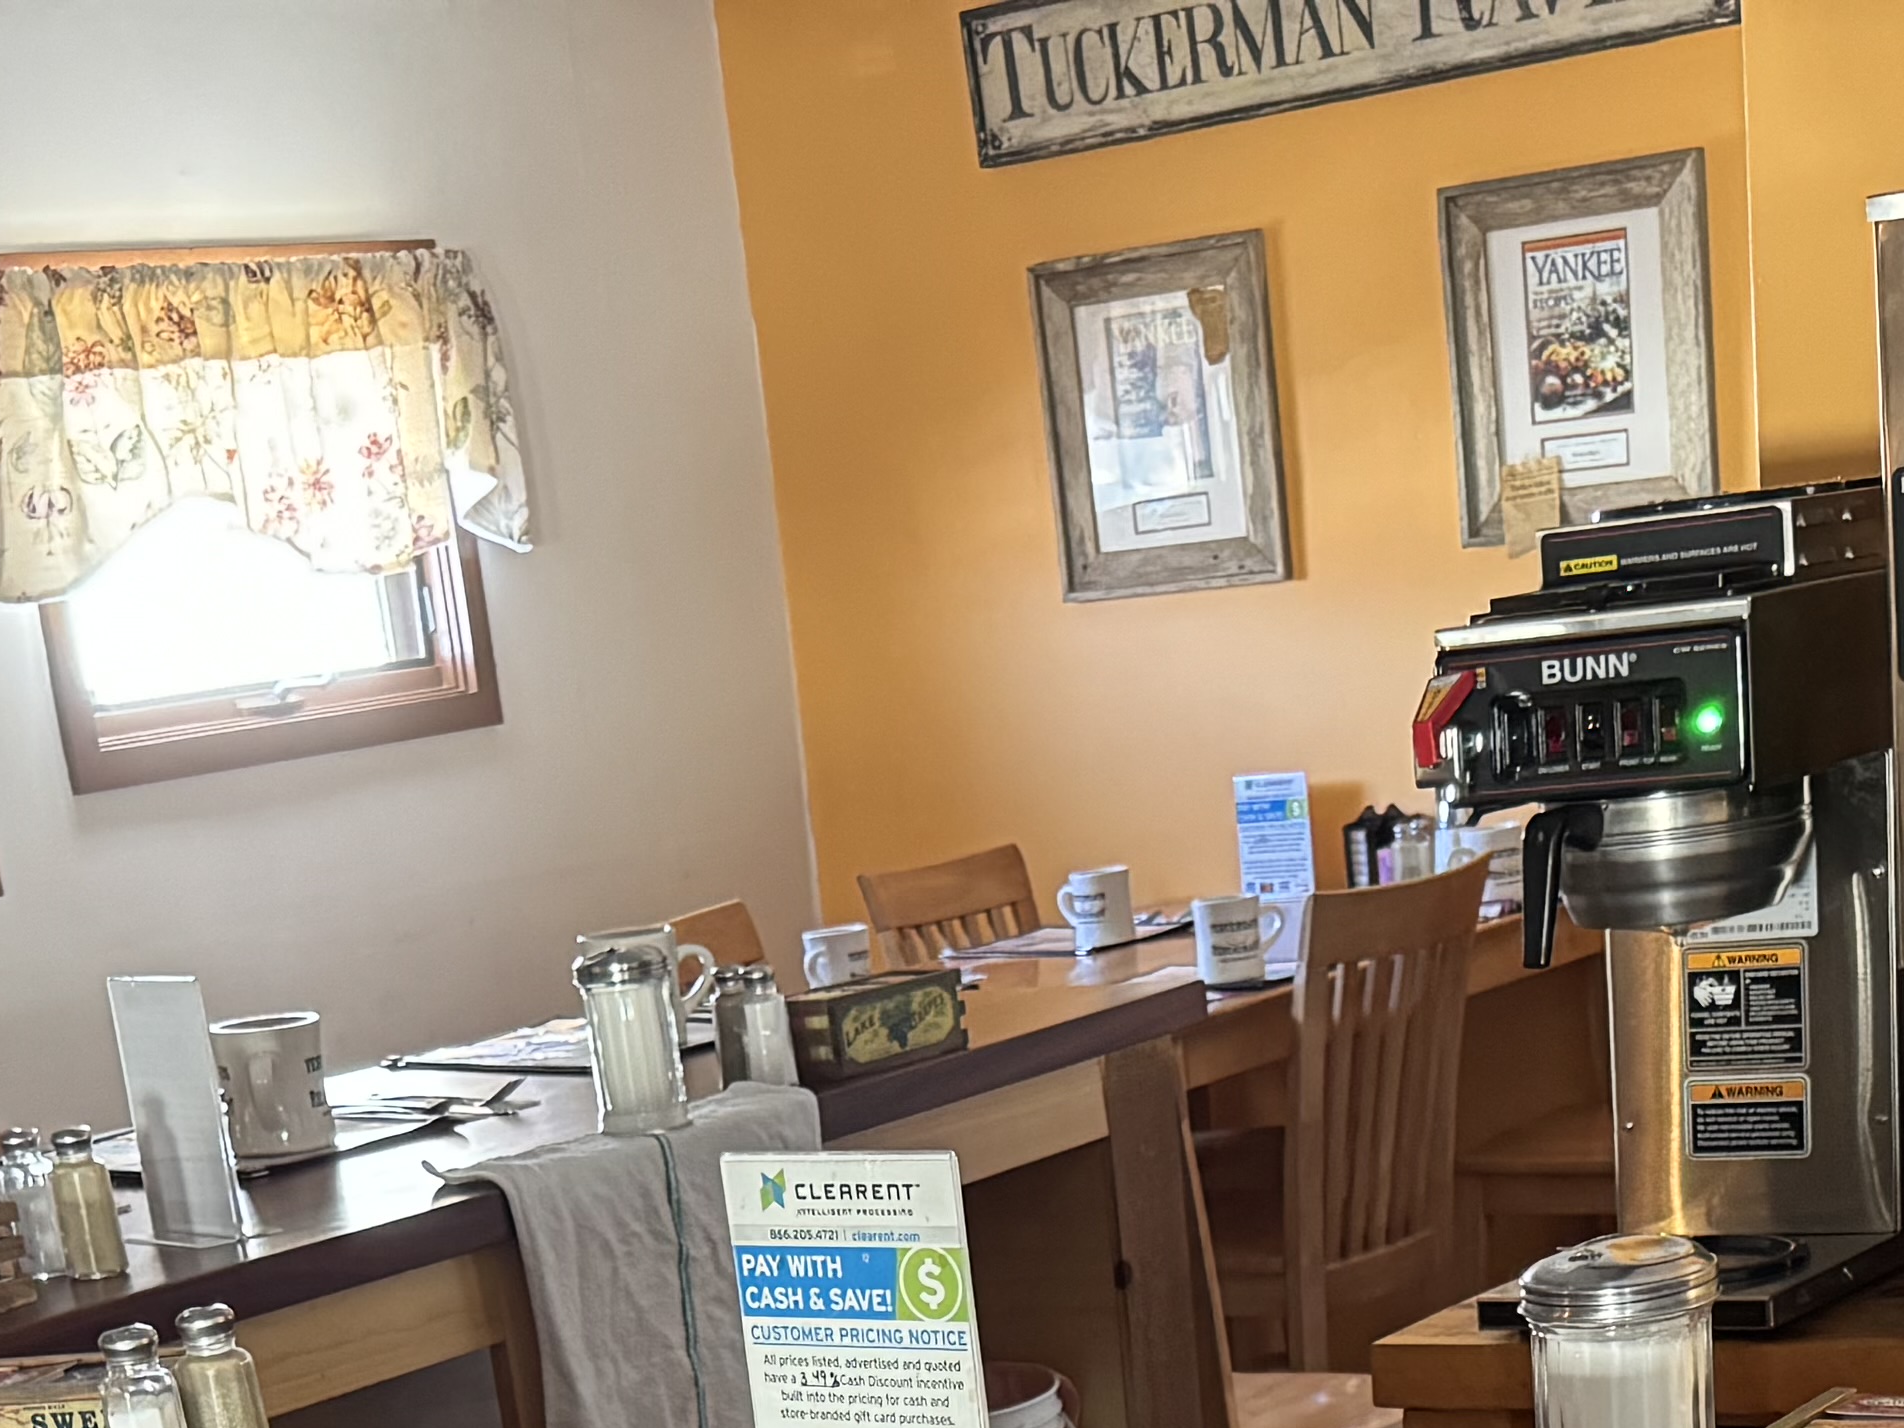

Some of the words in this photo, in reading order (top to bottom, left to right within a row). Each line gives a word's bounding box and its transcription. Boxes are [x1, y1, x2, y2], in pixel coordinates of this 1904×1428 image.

[982, 0, 1378, 123] TUCKERMAN
[1530, 247, 1624, 287] YANKEE
[1573, 559, 1613, 571] CAUTION
[1723, 545, 1739, 554] ARE
[1740, 542, 1758, 551] HOT
[1541, 651, 1631, 685] BUNN
[1727, 953, 1779, 965] WARNING
[846, 1014, 877, 1048] LAKE
[1725, 1085, 1784, 1098] WARNING
[794, 1183, 914, 1201] CLEARENT
[851, 1231, 921, 1243] clearent.com
[741, 1253, 781, 1278] PAY
[785, 1254, 843, 1279] WITH
[746, 1285, 804, 1311] CASH
[809, 1288, 825, 1311] &
[829, 1288, 893, 1312] SAVE!
[751, 1325, 834, 1342] CUSTOMER
[839, 1327, 904, 1345] PRICING
[909, 1329, 968, 1346] NOTICE
[763, 1354, 777, 1365] All
[779, 1355, 809, 1369] prices
[811, 1356, 842, 1369] listed,
[845, 1357, 899, 1370] advertised
[903, 1359, 921, 1371] and
[924, 1360, 961, 1375] quoted
[764, 1372, 788, 1384] have
[790, 1375, 797, 1384] a
[839, 1375, 865, 1387] Cash
[868, 1375, 913, 1389] Discount
[916, 1373, 964, 1390] incentive
[781, 1390, 804, 1402] built
[806, 1391, 825, 1403] into
[828, 1392, 844, 1403] the
[848, 1394, 883, 1409] pricing
[886, 1394, 900, 1406] for
[903, 1396, 927, 1407] cash
[931, 1396, 950, 1408] and
[780, 1406, 851, 1422] store-branded
[854, 1411, 870, 1424] gift
[874, 1411, 896, 1423] card
